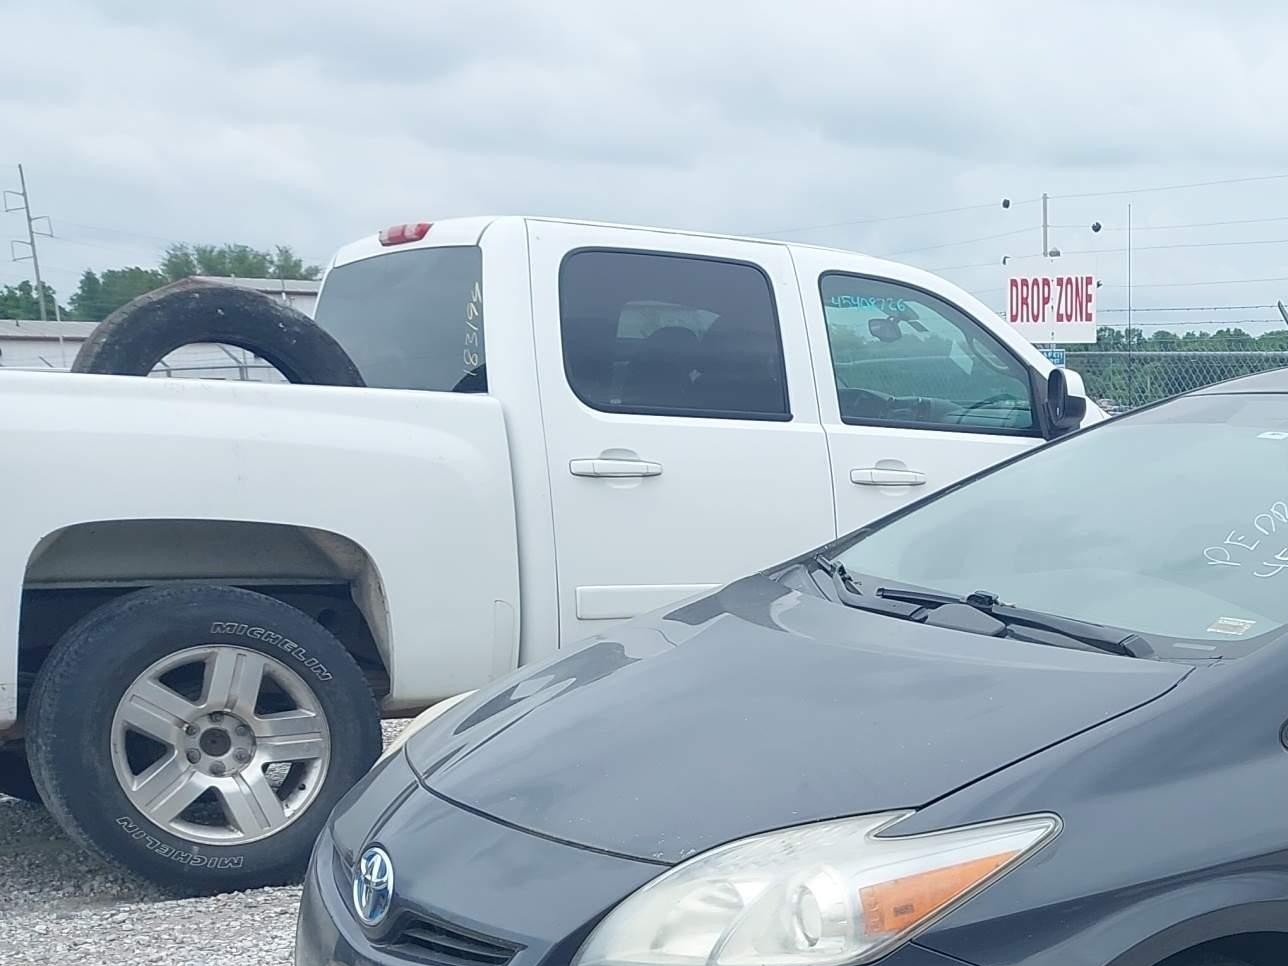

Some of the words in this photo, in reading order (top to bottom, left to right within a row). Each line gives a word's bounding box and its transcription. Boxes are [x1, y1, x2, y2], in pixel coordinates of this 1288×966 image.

[1009, 278, 1050, 323] DROP
[1056, 276, 1093, 322] ZONE
[210, 622, 333, 682] MICHELIN
[116, 816, 244, 869] MICHELIN
